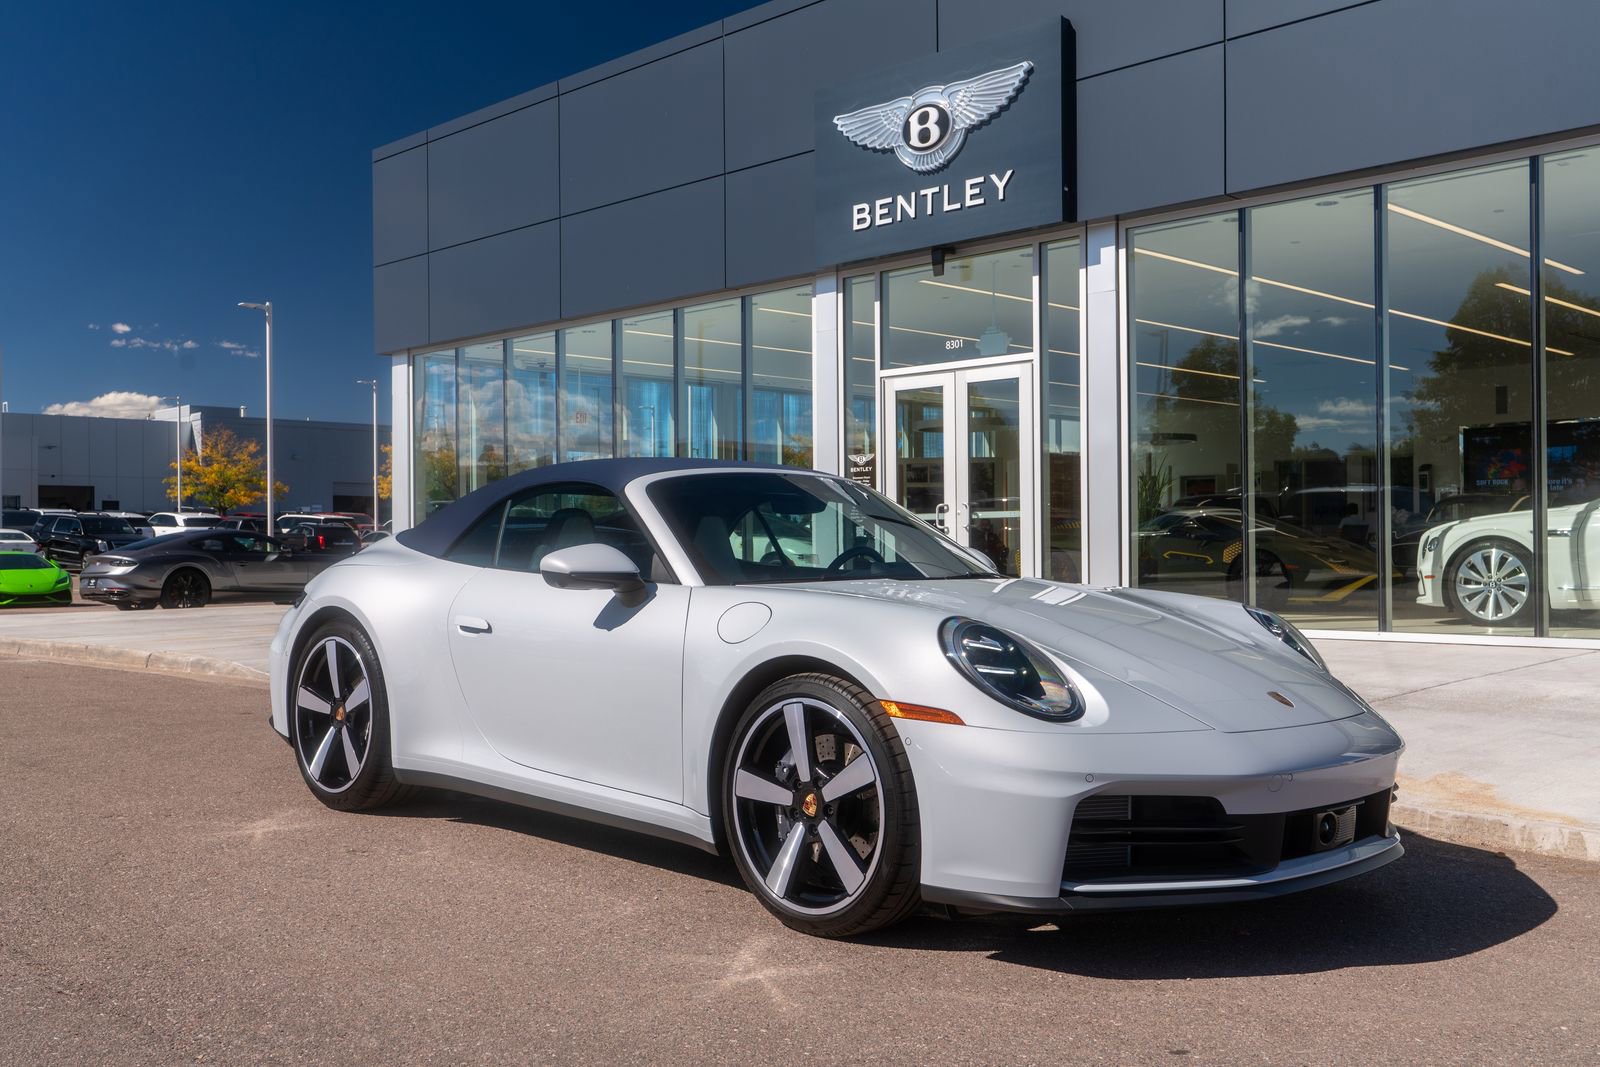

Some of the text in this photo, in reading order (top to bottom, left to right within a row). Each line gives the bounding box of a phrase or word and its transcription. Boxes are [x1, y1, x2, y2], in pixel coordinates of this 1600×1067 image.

[909, 107, 941, 148] B
[852, 169, 1014, 231] BENTLEY
[945, 339, 963, 350] 8301
